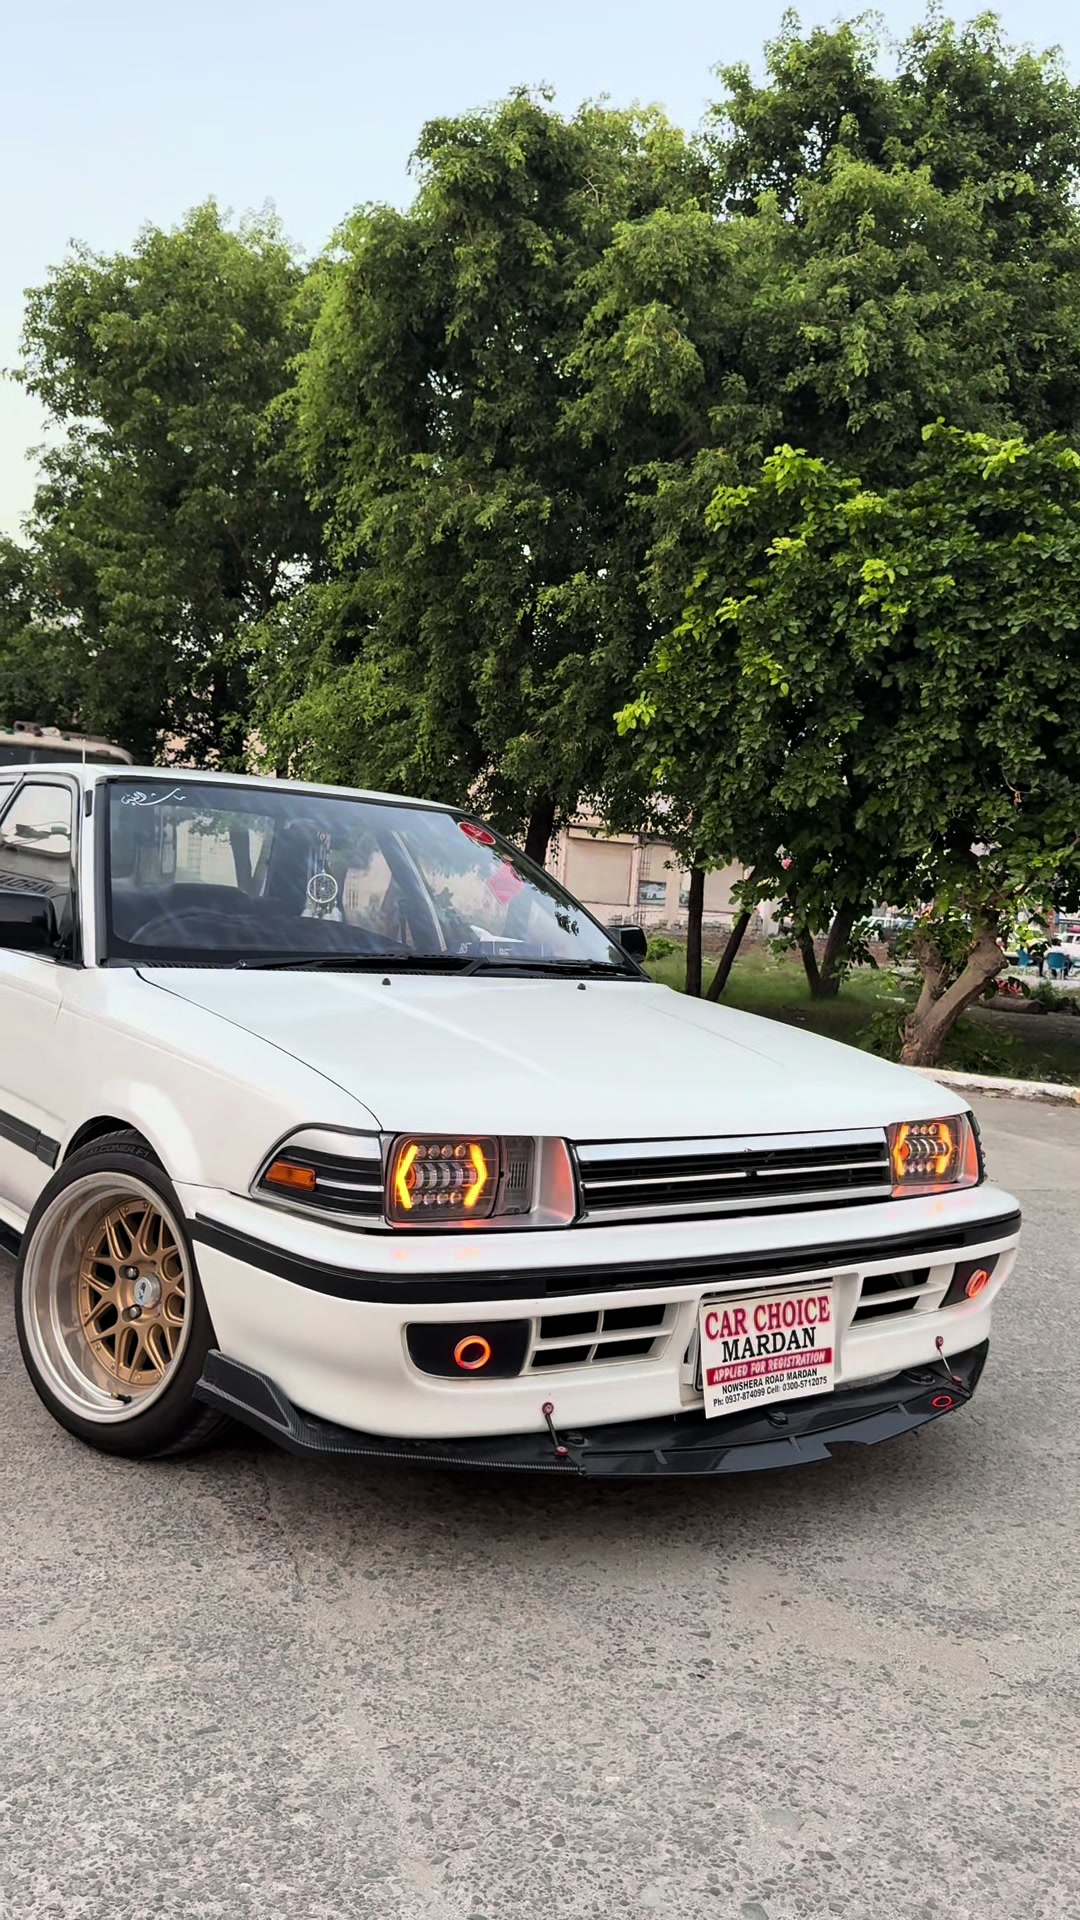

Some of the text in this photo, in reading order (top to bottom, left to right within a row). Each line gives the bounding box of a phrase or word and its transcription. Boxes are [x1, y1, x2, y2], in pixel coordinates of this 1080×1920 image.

[705, 1296, 830, 1340] CAR CHOICE
[722, 1326, 816, 1363] MARDAN
[713, 1351, 826, 1382] APPLIED FOR REGISTRATION
[722, 1368, 818, 1394] NOWSHERA ROAD MARDAN
